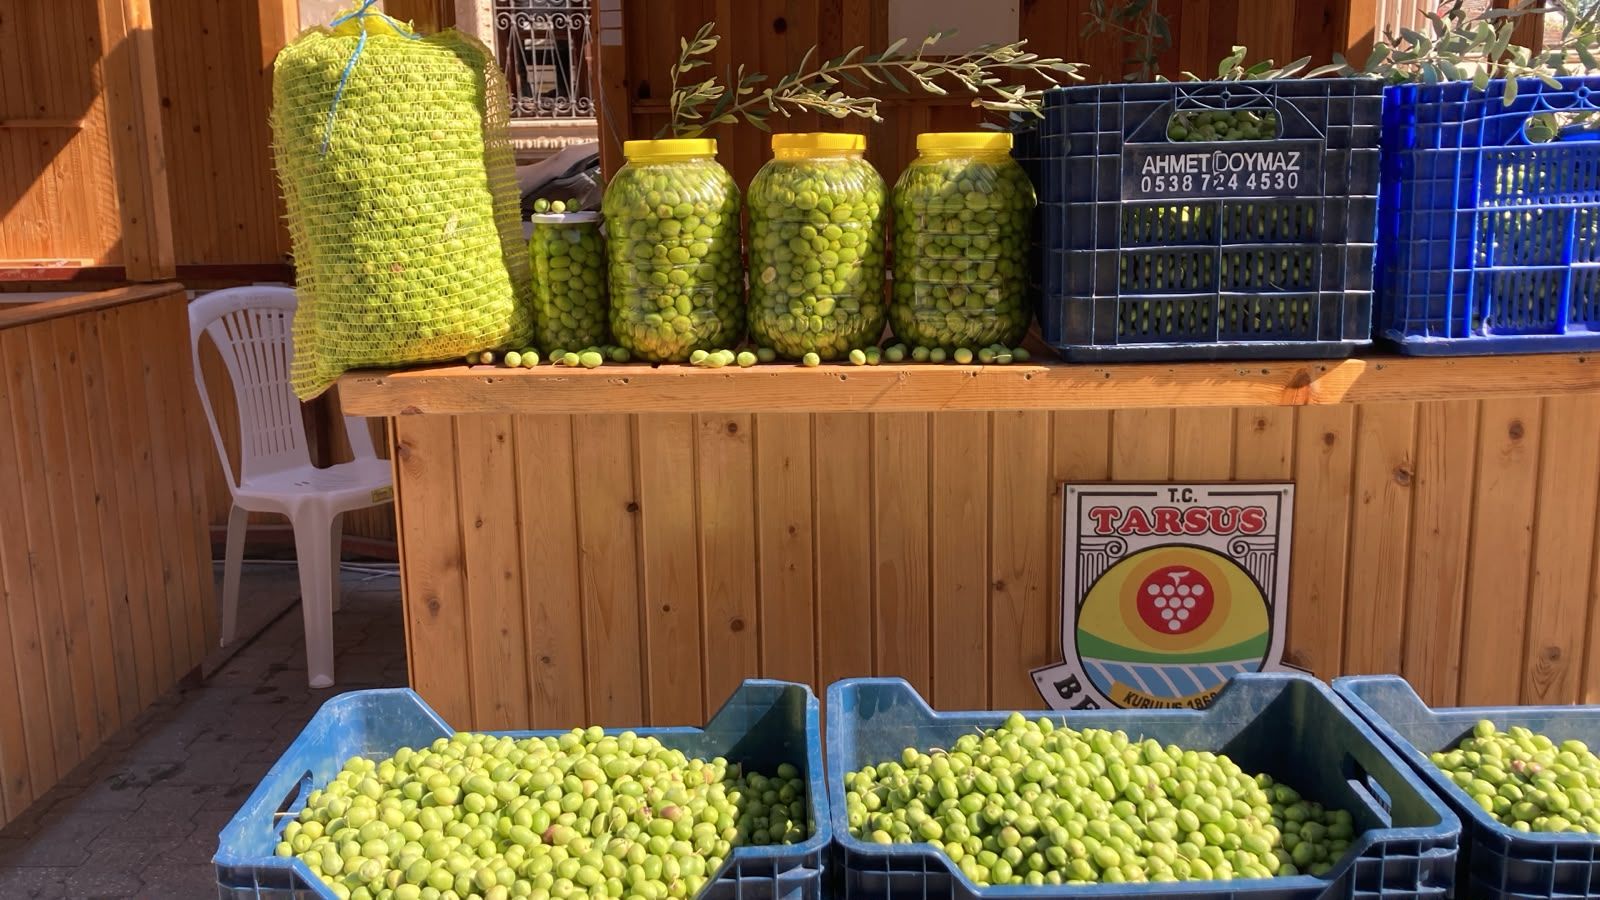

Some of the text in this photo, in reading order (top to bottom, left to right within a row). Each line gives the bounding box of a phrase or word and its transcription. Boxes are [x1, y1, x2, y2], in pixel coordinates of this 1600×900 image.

[1141, 151, 1300, 175] AHMET DOYMAZ
[1141, 172, 1299, 193] 0538 724 4530
[1167, 487, 1198, 503] T.C.
[1088, 505, 1267, 536] TARSUS
